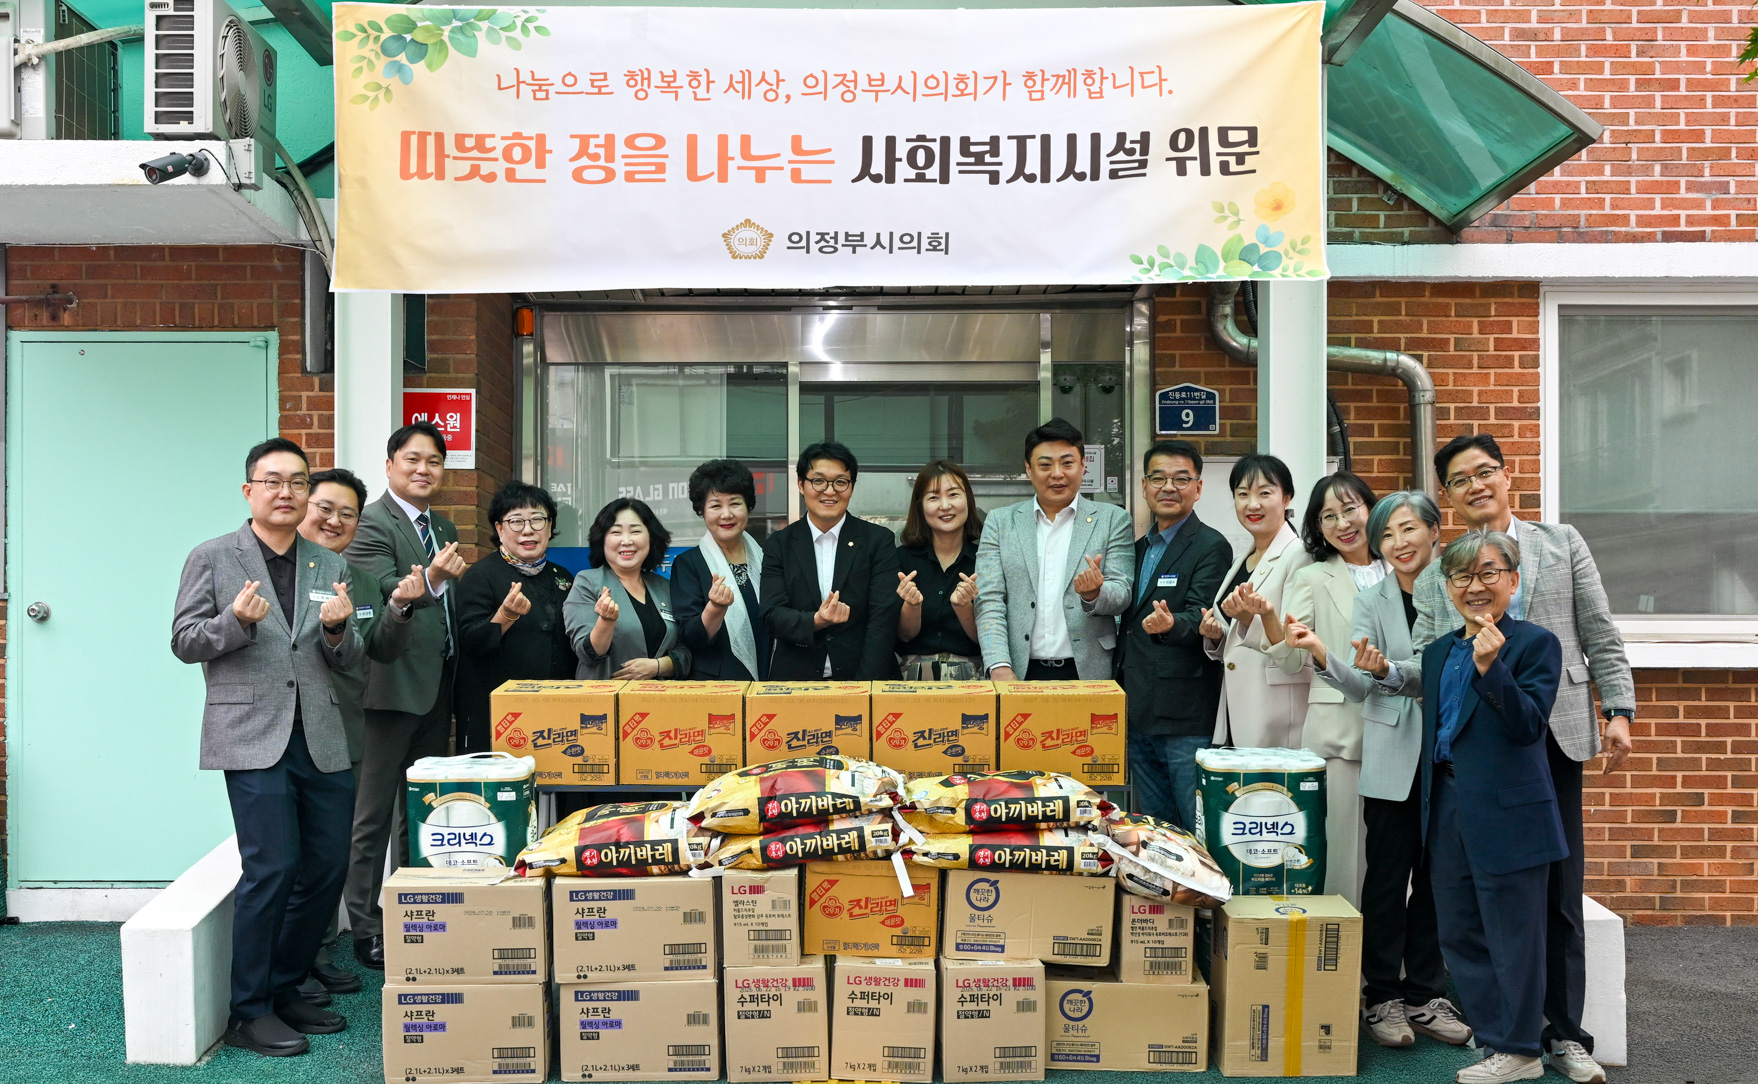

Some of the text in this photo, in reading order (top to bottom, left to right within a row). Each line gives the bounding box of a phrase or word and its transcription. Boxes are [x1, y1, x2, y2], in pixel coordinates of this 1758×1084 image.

[494, 65, 1174, 103] 나눔으로 행복한 세상, 의정부시의회가 함께합니다.
[400, 125, 1260, 186] 따뜻한 정을 나누는 사회복지시설 위문
[737, 236, 758, 247] 의회
[786, 231, 950, 255] 의정부시의회
[1168, 391, 1207, 399] 진등로11번길
[1181, 408, 1194, 428] 9
[531, 727, 578, 750] 진라면
[658, 728, 705, 750] 진라면
[786, 728, 833, 752] 진라면
[911, 727, 959, 751] 진라면
[1039, 727, 1088, 751] 진라면
[780, 795, 855, 816] 아끼바레
[990, 800, 1063, 822] 아끼바레
[1231, 821, 1296, 837] 크리넥스
[430, 832, 495, 847] 크리넥스
[785, 831, 859, 858] 아끼바레
[600, 842, 673, 866] 아끼바레
[994, 849, 1068, 869] 아끼바레
[731, 885, 747, 895] LG
[973, 888, 993, 897] 깨끗한
[575, 907, 607, 919] 샤프란
[847, 896, 899, 920] 진라면
[1131, 904, 1147, 915] LG
[403, 910, 436, 921] 샤프란
[968, 913, 994, 924] 물티슈
[404, 923, 446, 932] 릴렉싱 아로마
[575, 920, 618, 930] 릴렉싱 아로마
[736, 993, 783, 1007] 수퍼타이
[847, 990, 893, 1006] 수퍼타이
[956, 993, 1003, 1007] 수퍼타이
[1066, 998, 1087, 1007] 깨끗한
[403, 1010, 436, 1021] 샤프란
[580, 1007, 611, 1018] 샤프란
[738, 1010, 771, 1019] 절약형/N
[847, 1007, 880, 1017] 절약형/N
[957, 1010, 990, 1019] 절약형/N
[1069, 1006, 1083, 1014] 나라
[404, 1023, 446, 1032] 릴렉싱 아로마
[580, 1020, 622, 1029] 릴렉싱 아로마
[1062, 1024, 1089, 1034] 물티슈
[744, 1066, 751, 1075] kg
[762, 1065, 772, 1074] 개입
[849, 1063, 856, 1073] kg
[867, 1063, 877, 1072] 개입
[961, 1066, 968, 1075] kg
[979, 1065, 989, 1074] 개입
